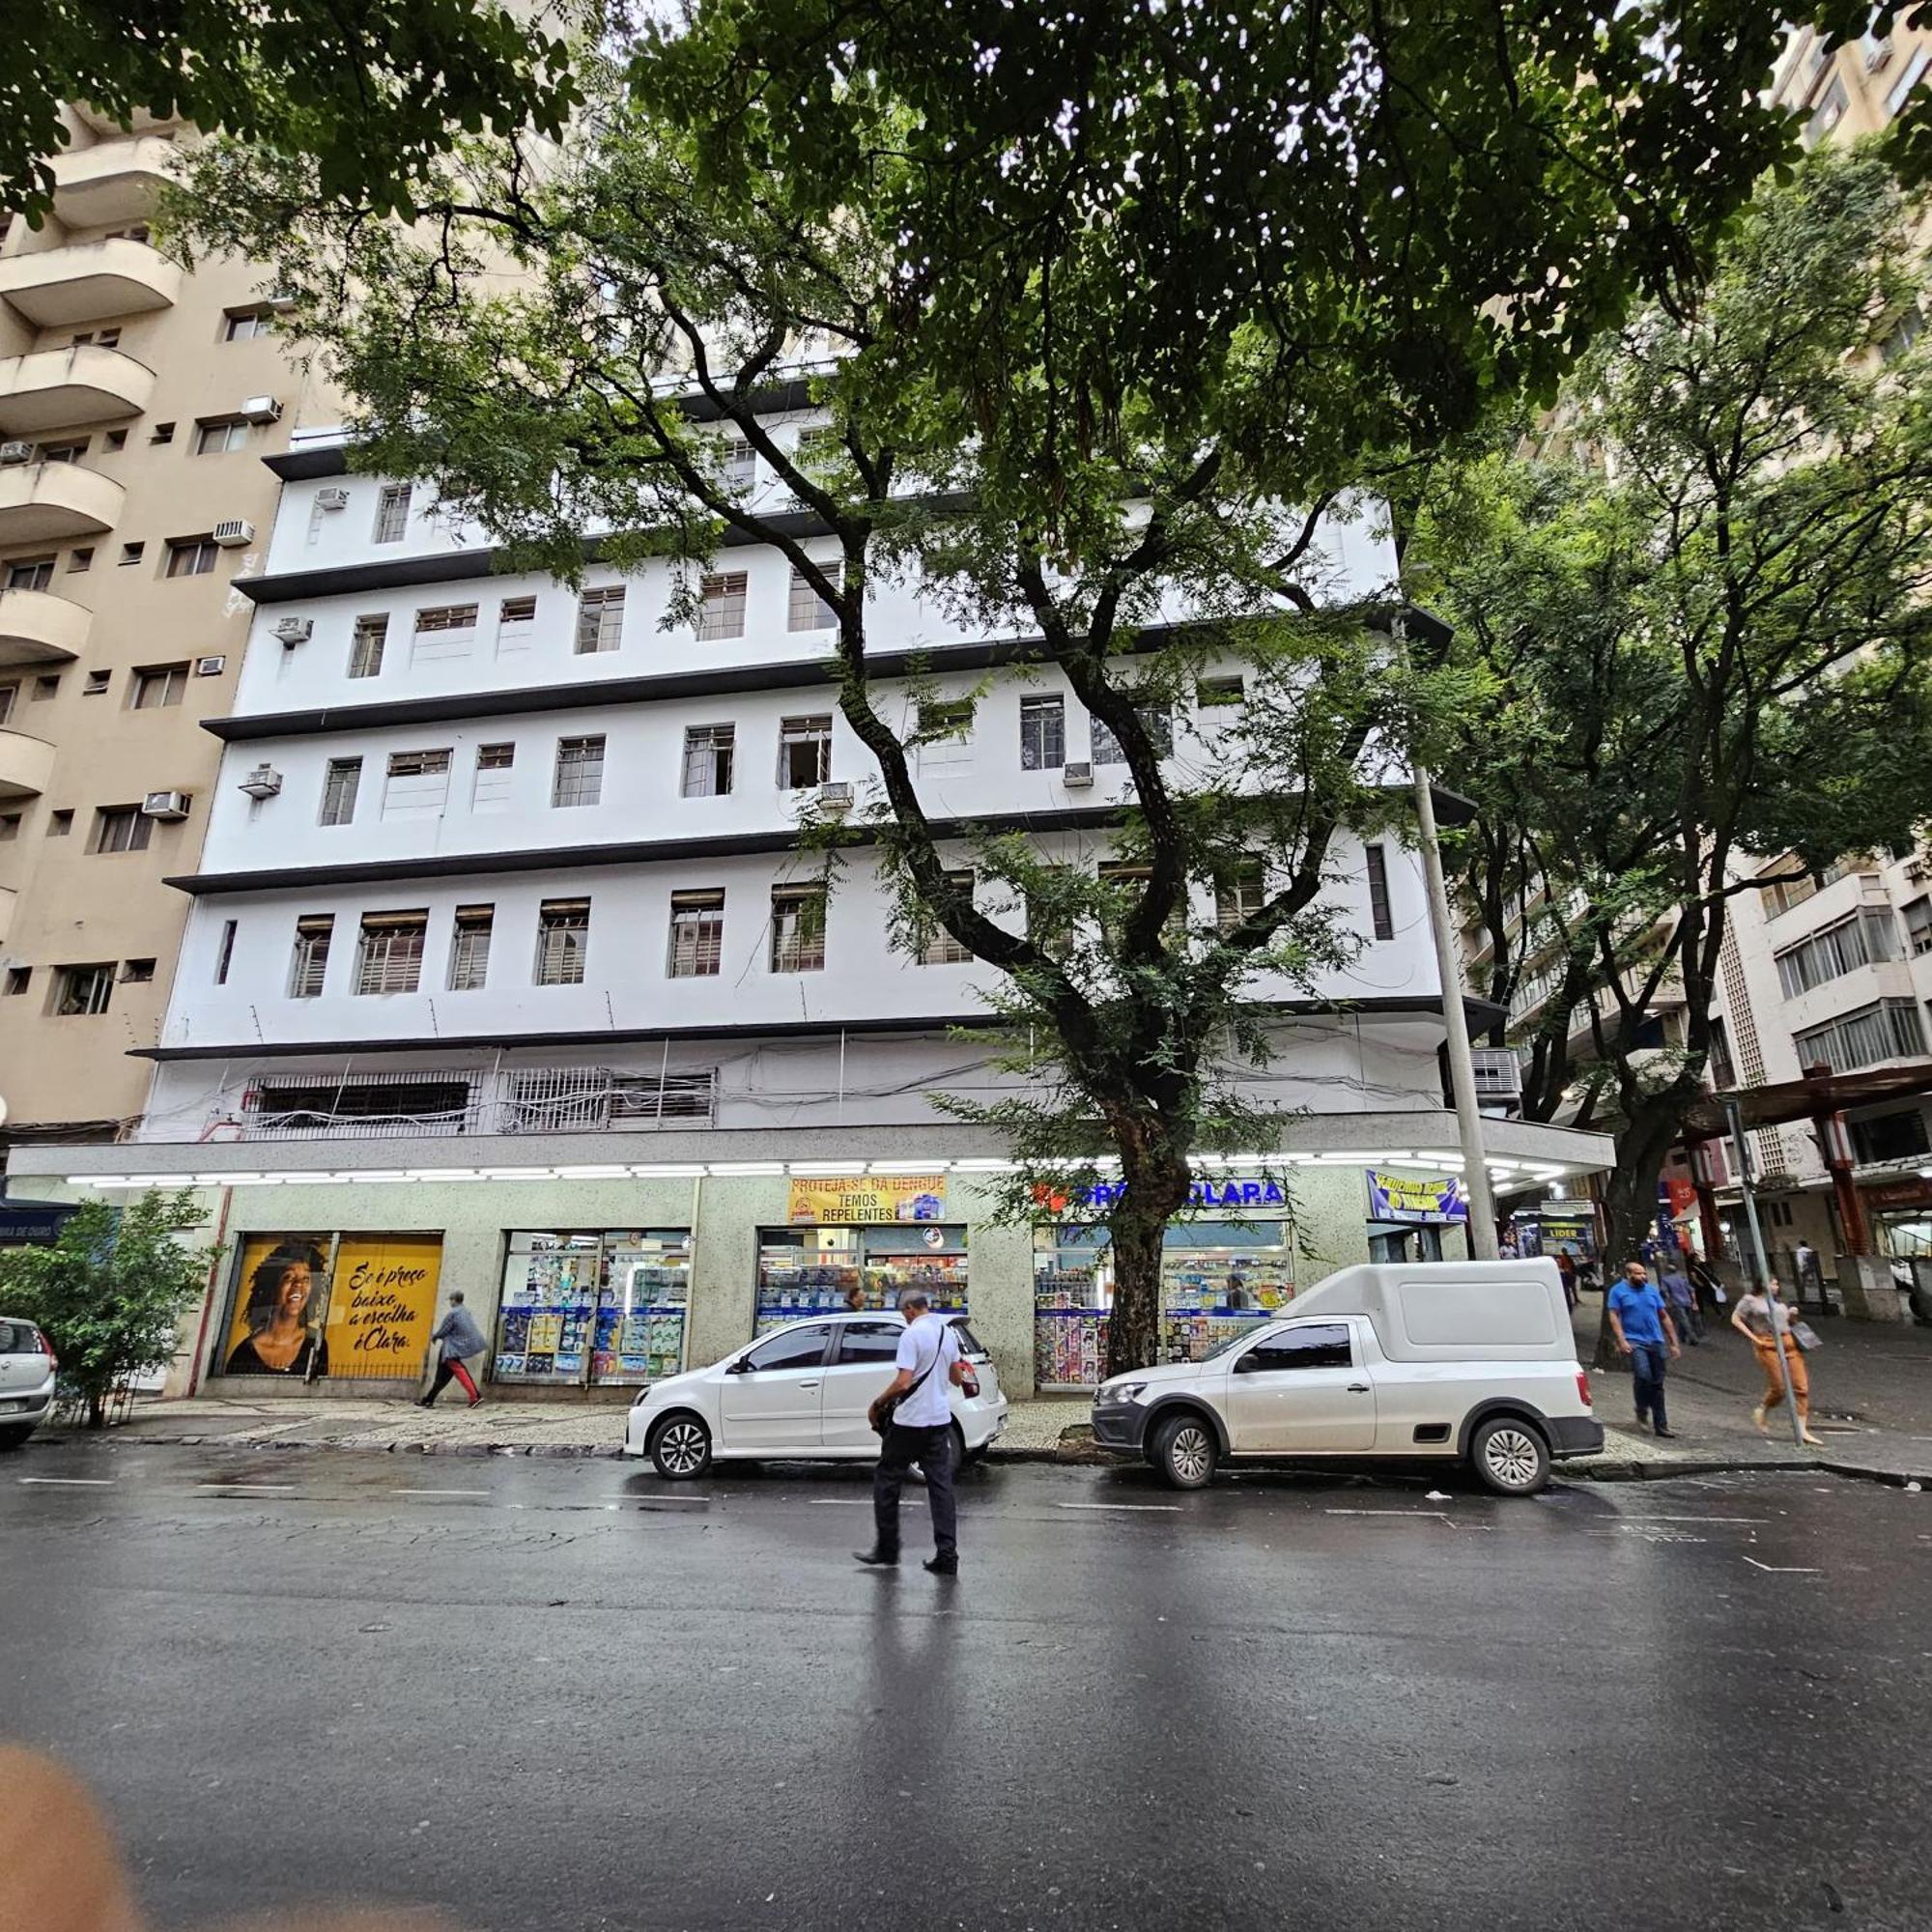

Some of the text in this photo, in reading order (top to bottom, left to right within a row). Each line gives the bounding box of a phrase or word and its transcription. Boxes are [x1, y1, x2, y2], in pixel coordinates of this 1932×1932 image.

[792, 1176, 944, 1192] PROTEJA-SE DA DENGUE
[839, 1194, 877, 1208] TEMOS
[822, 1208, 893, 1222] REPELENTES
[383, 1265, 426, 1288] preço
[349, 1304, 415, 1325] a escolha
